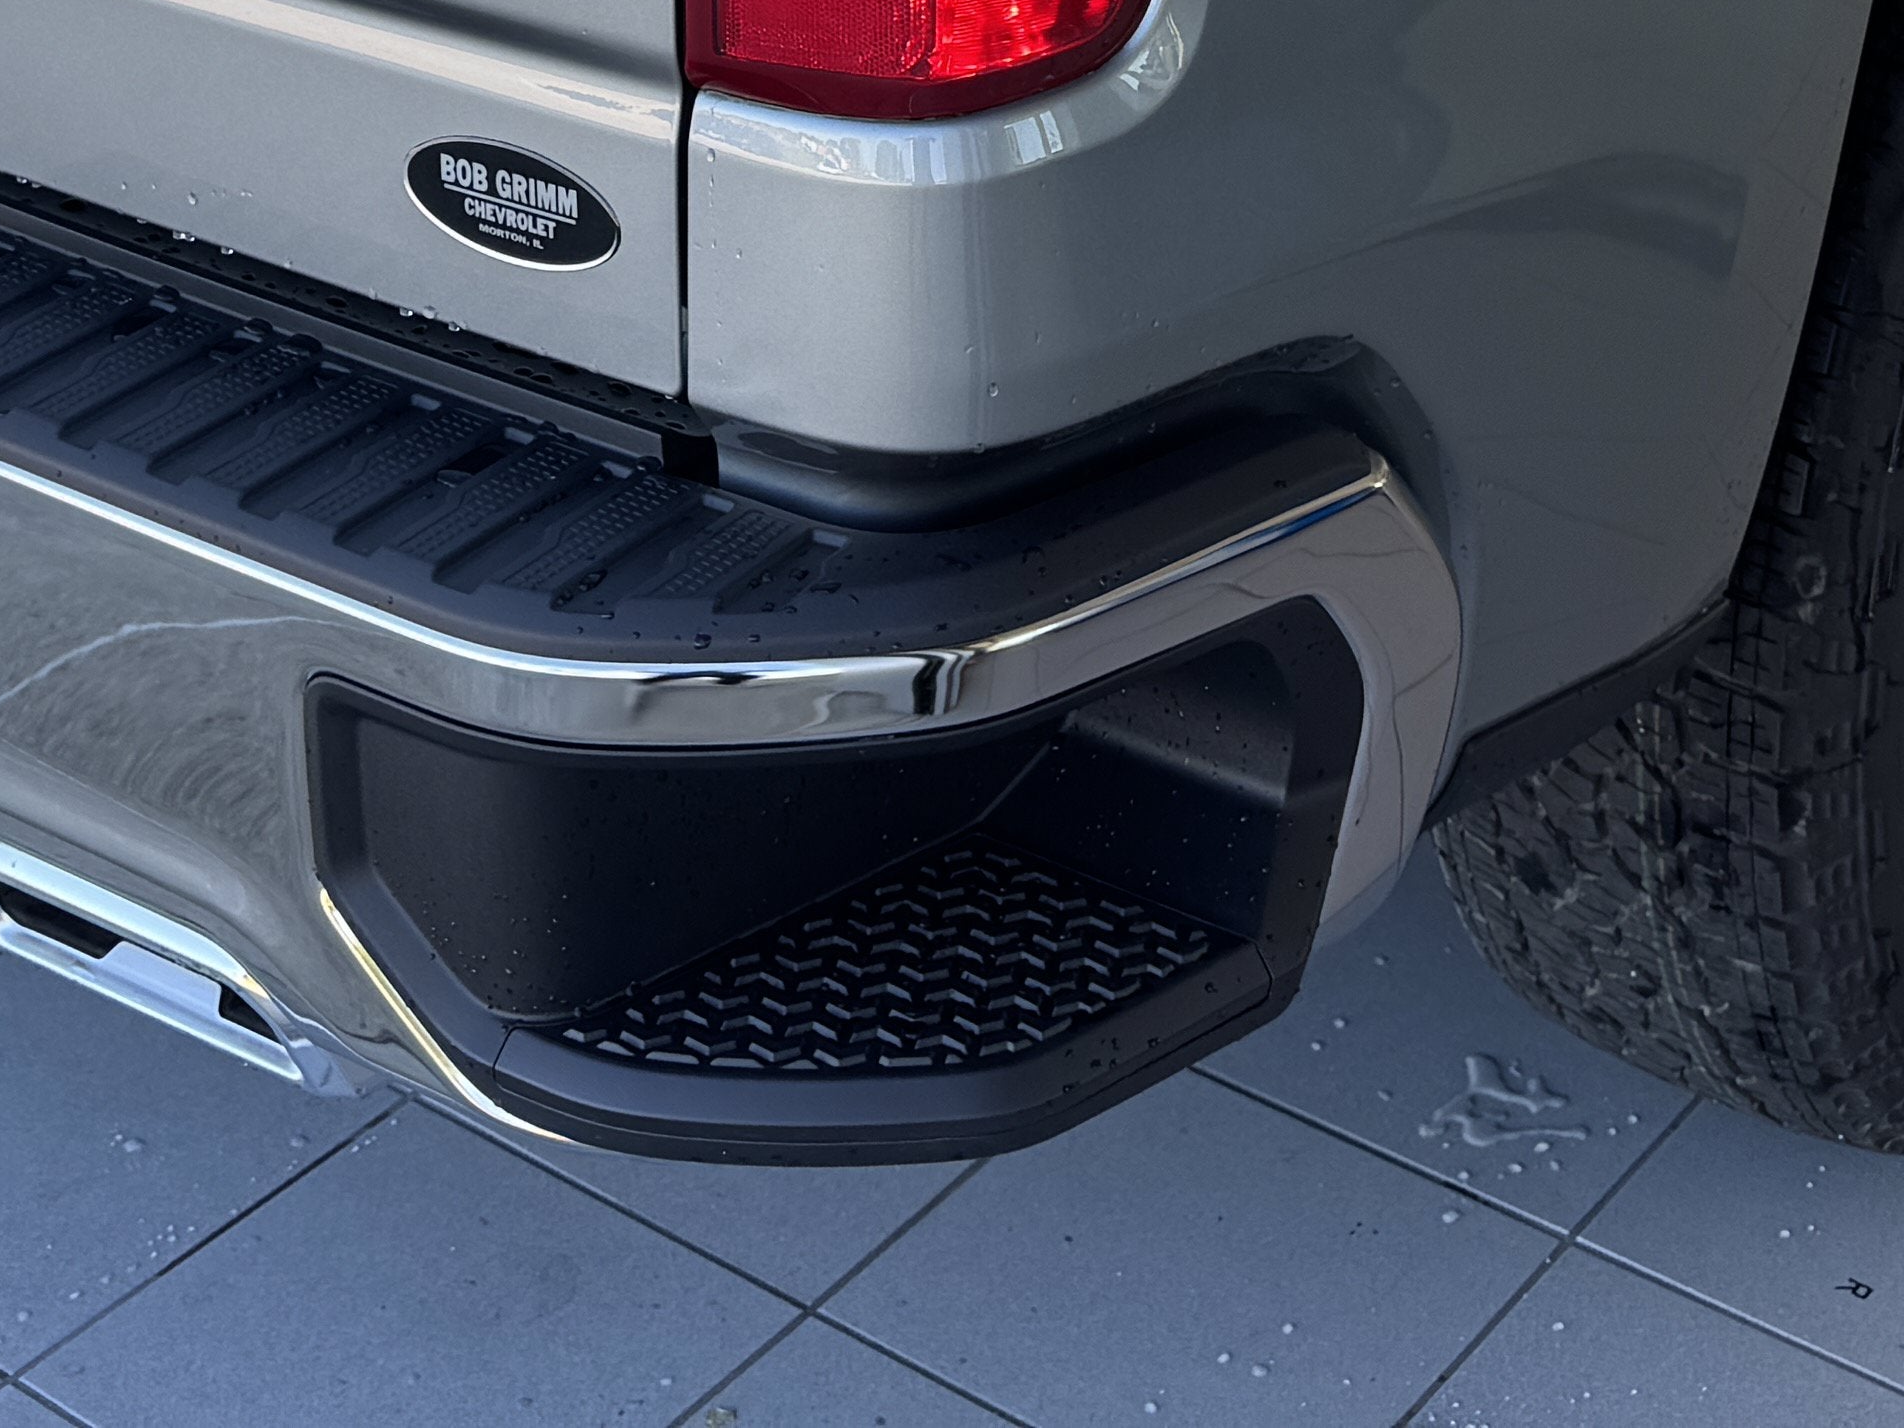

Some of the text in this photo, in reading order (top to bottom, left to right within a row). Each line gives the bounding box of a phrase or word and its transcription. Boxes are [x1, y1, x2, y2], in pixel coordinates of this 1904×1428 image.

[439, 152, 579, 219] BOB GRIMM
[463, 196, 557, 240] CHEVROLET
